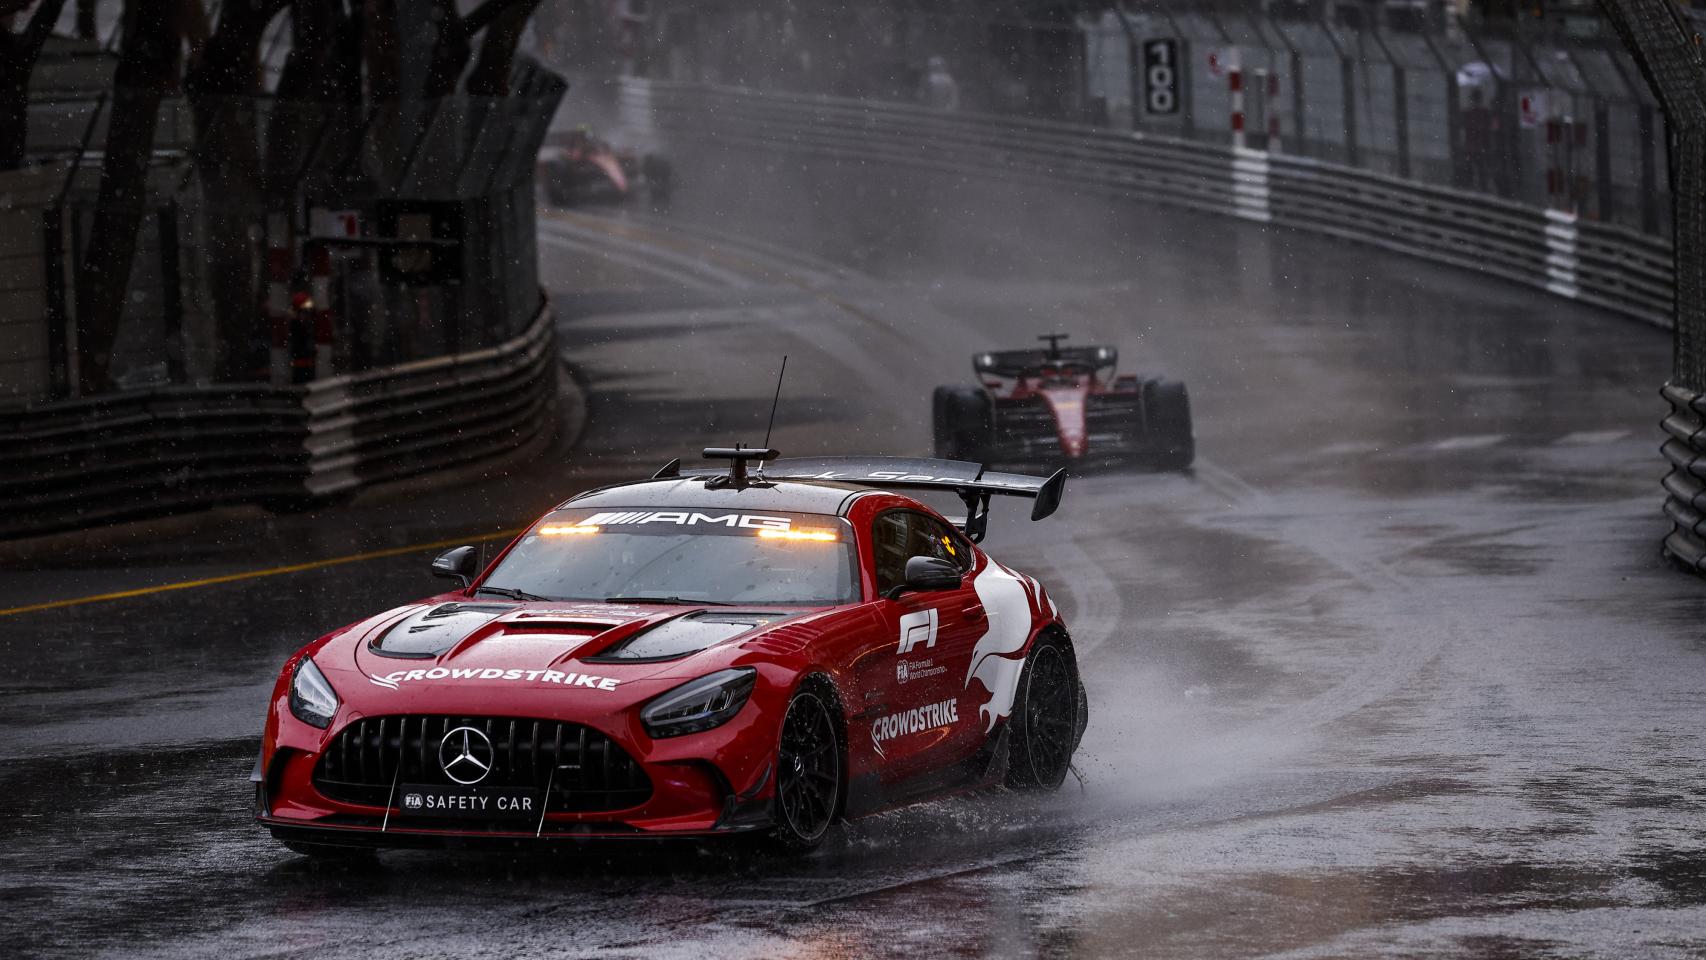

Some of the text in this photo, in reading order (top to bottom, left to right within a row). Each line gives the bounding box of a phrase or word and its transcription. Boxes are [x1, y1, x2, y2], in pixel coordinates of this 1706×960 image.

[1150, 43, 1173, 111] 100
[638, 512, 792, 530] AMG
[896, 608, 939, 655] F1
[385, 667, 621, 691] CROWDSTRIKE
[897, 660, 908, 684] FIA
[872, 698, 959, 741] CROWDSTRIKE
[404, 794, 532, 810] FIA SAFETY CAR
